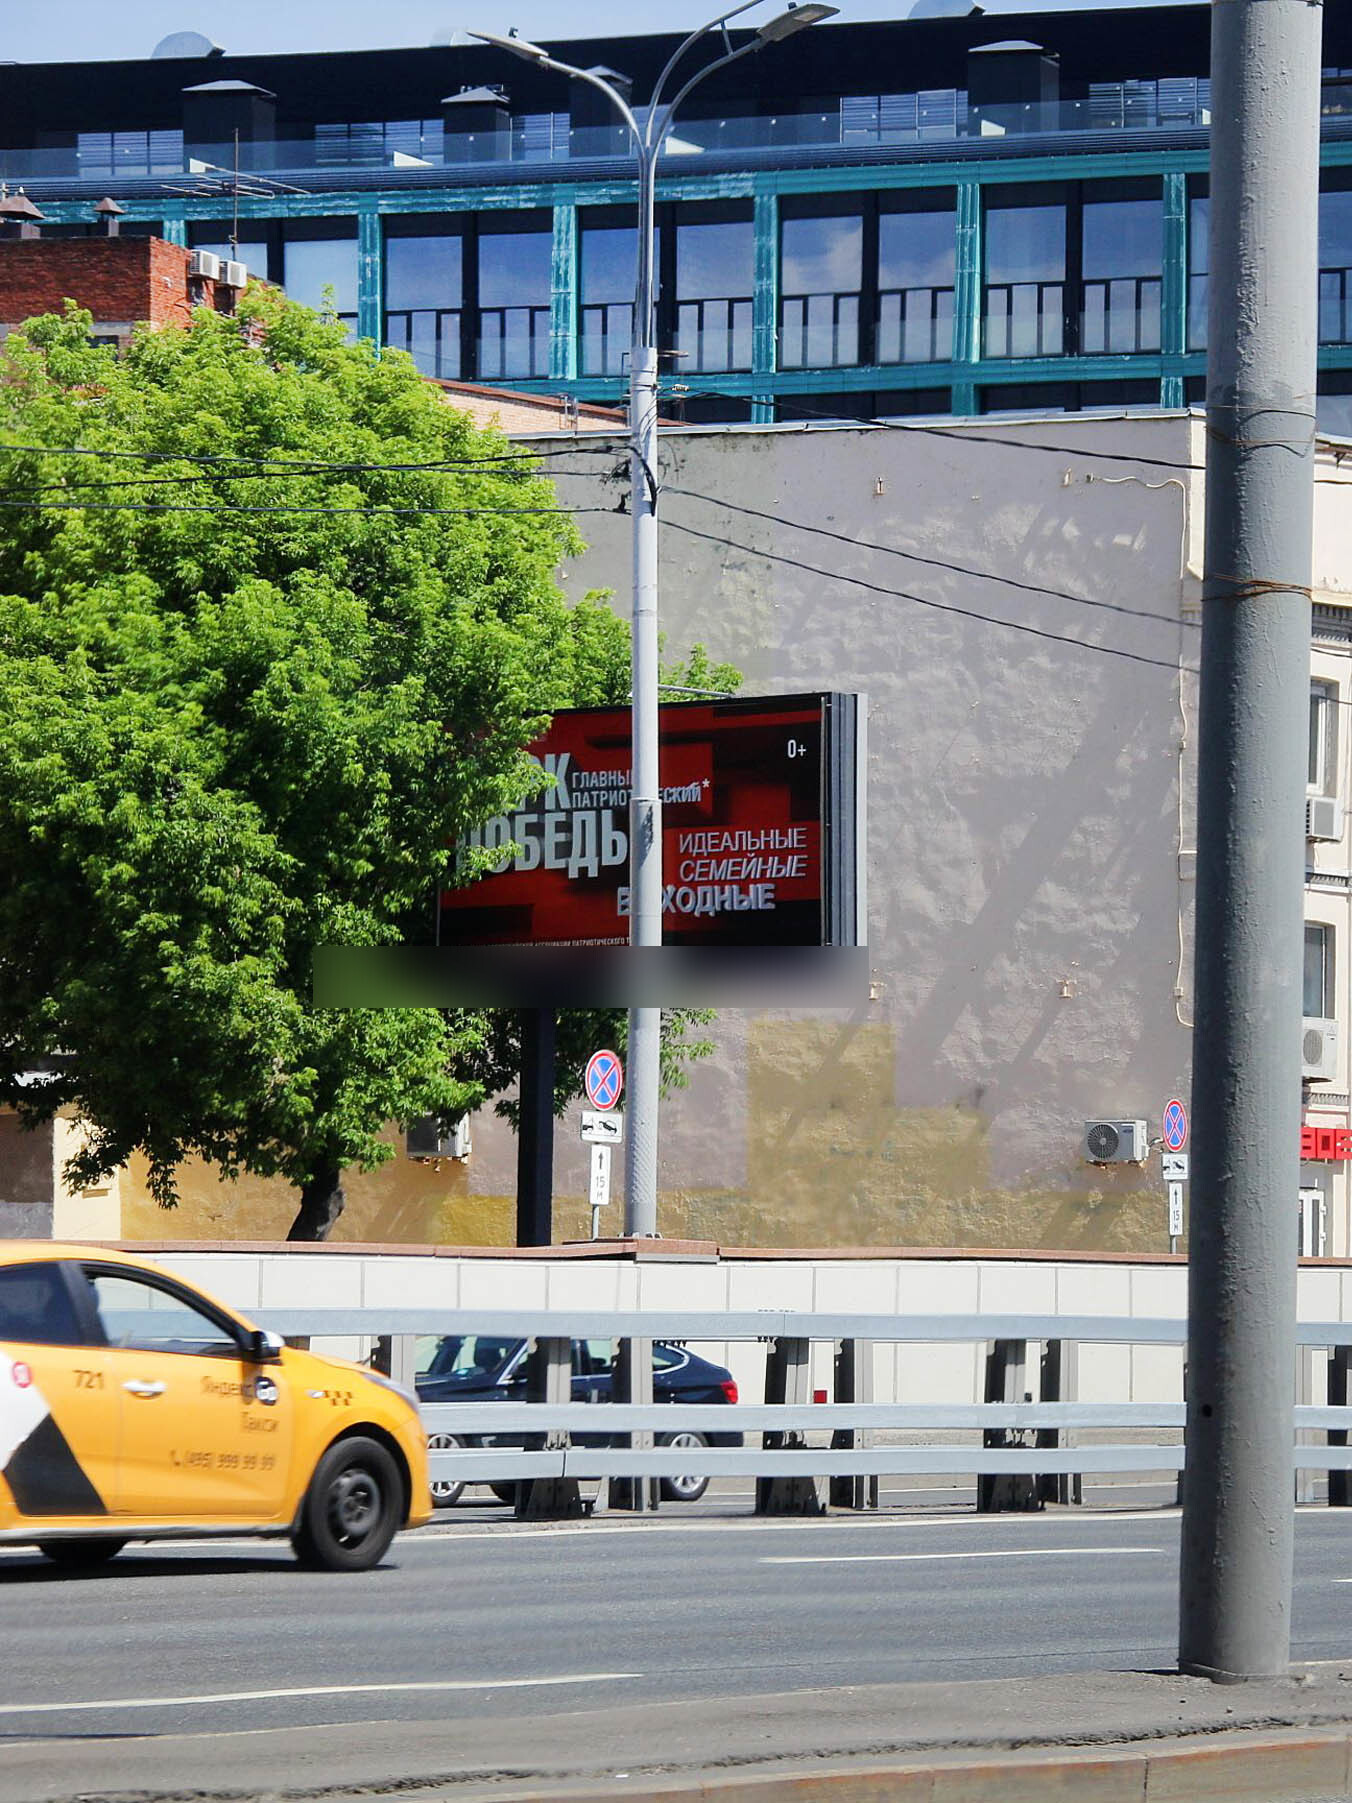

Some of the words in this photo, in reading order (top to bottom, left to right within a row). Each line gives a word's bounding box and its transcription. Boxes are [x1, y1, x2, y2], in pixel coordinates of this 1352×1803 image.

[787, 739, 807, 758] 0+
[572, 769, 632, 789] ГЛАВНЫ
[679, 827, 808, 857] ИДЕАЛЬНЫЕ
[679, 852, 809, 882] СЕМЕЙНЫЕ
[617, 883, 776, 918] ВХОДНЫЕ
[595, 1175, 606, 1188] 15
[1173, 1209, 1180, 1222] 15
[72, 1369, 105, 1391] 721
